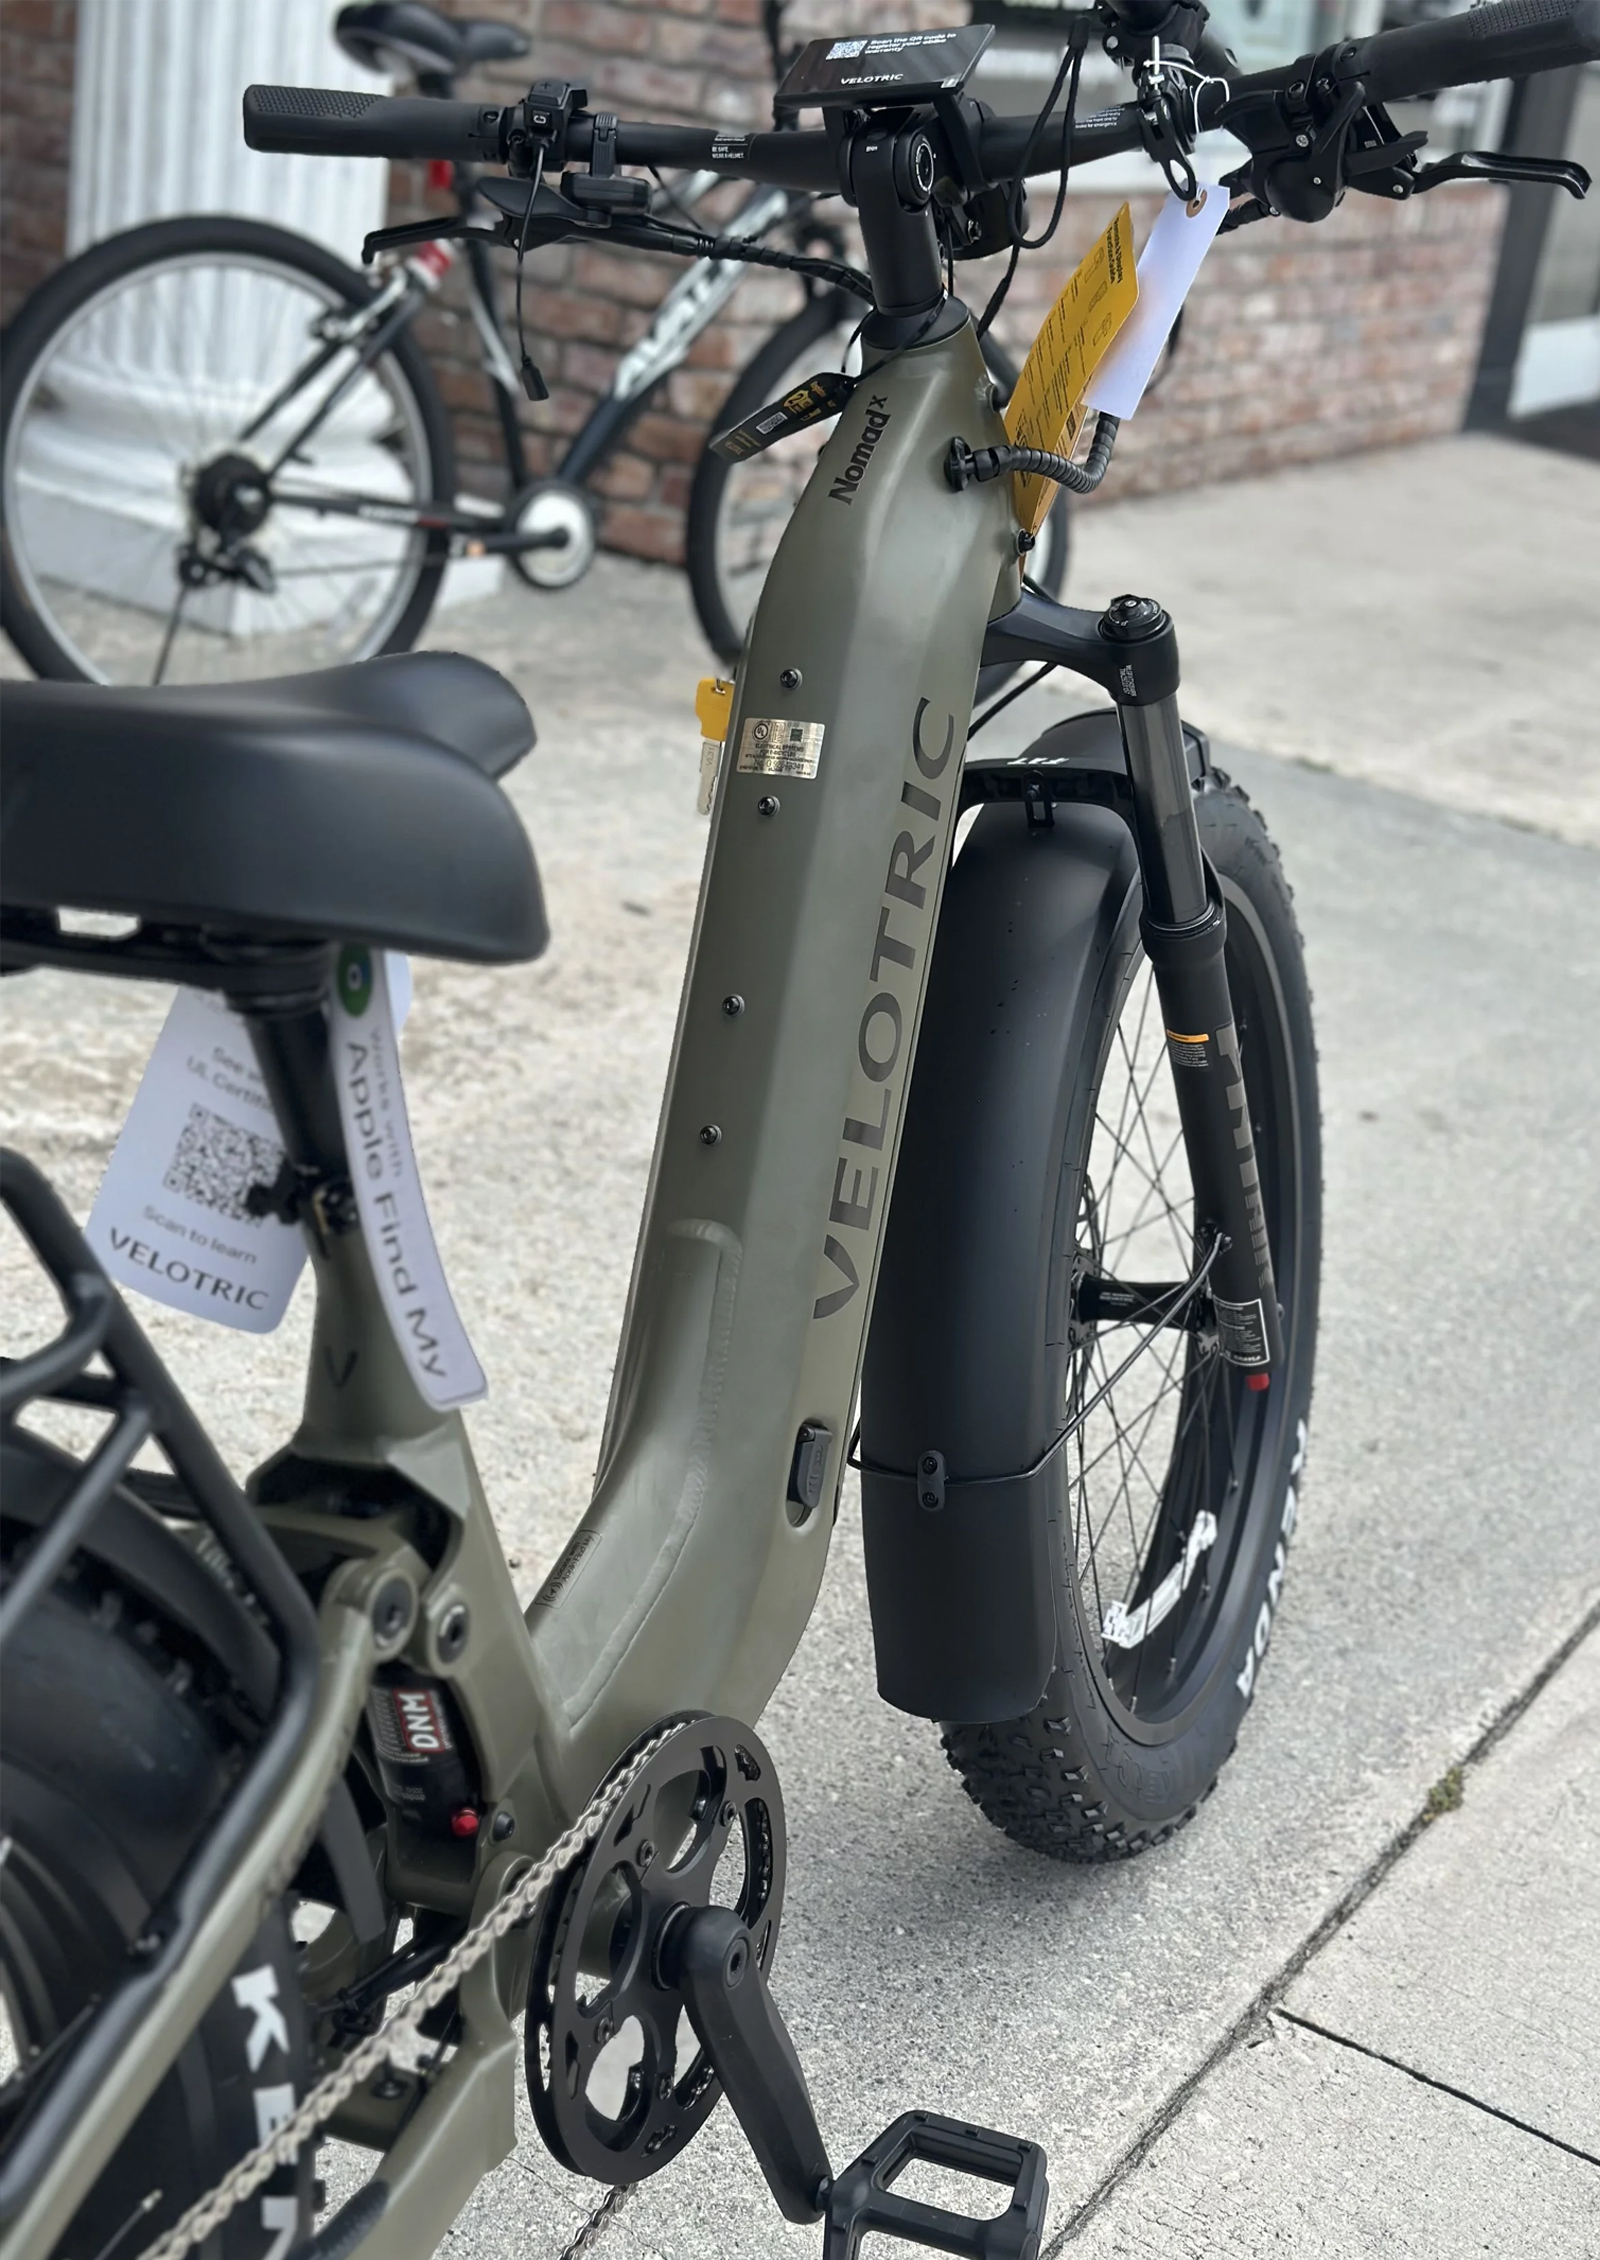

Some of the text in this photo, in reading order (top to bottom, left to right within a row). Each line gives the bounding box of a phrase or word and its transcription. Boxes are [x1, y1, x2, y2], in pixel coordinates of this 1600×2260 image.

[840, 73, 904, 85] VELOTRIC
[864, 46, 904, 54] warranty
[813, 697, 955, 1321] VELOTRIC
[142, 1204, 257, 1265] Scan to learn
[346, 1040, 447, 1379] Apple Find My
[110, 1225, 269, 1310] VELOTRIC
[398, 1693, 440, 1749] DNM
